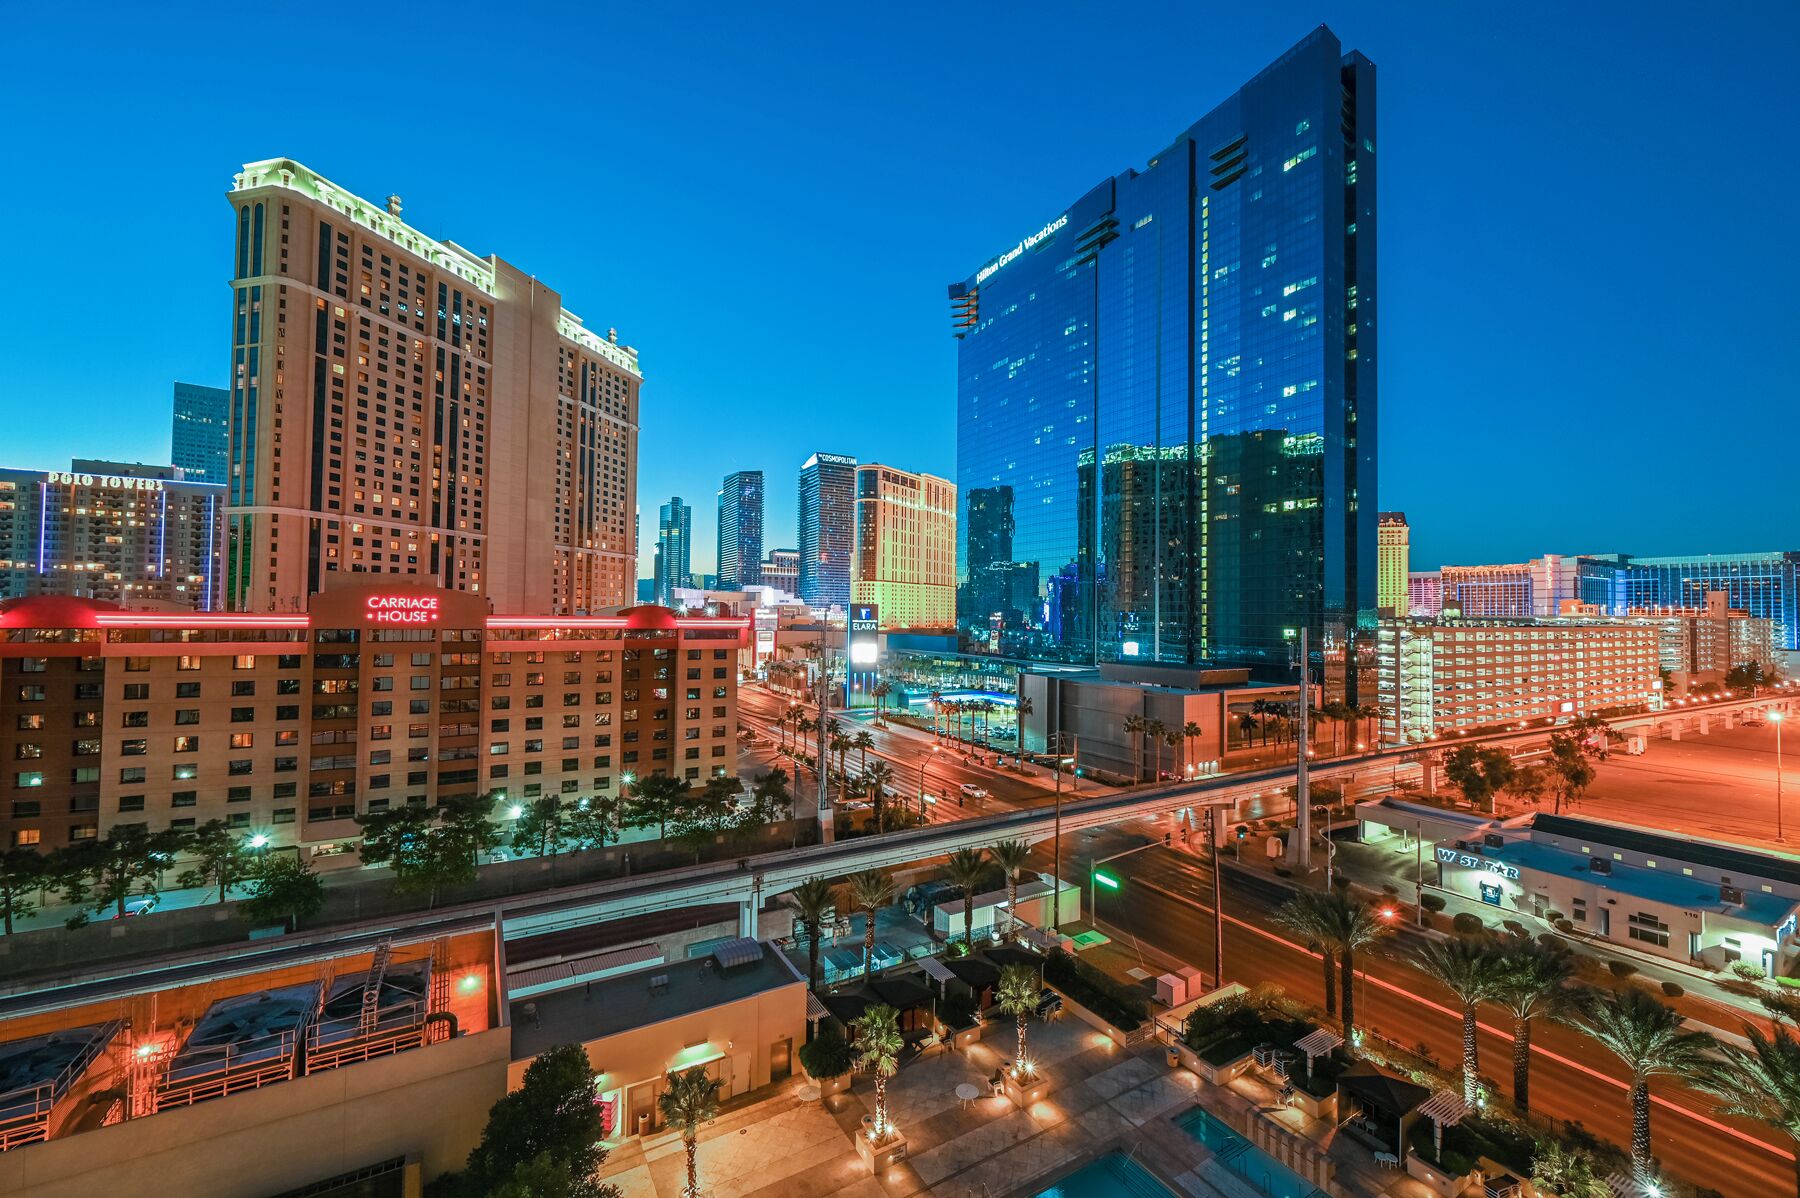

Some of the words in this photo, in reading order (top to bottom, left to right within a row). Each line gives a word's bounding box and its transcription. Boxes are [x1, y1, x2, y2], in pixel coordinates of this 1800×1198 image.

[976, 262, 999, 284] Hilton
[999, 242, 1023, 267] Grand
[1023, 214, 1068, 250] Vacations
[821, 454, 857, 465] COSMOPOLITAN
[48, 472, 94, 486] POLO
[100, 476, 164, 491] TOWERS
[367, 597, 438, 609] CARRIAGE
[377, 610, 428, 622] HOUSE
[852, 622, 877, 631] ELARA
[1684, 911, 1699, 919] 110
